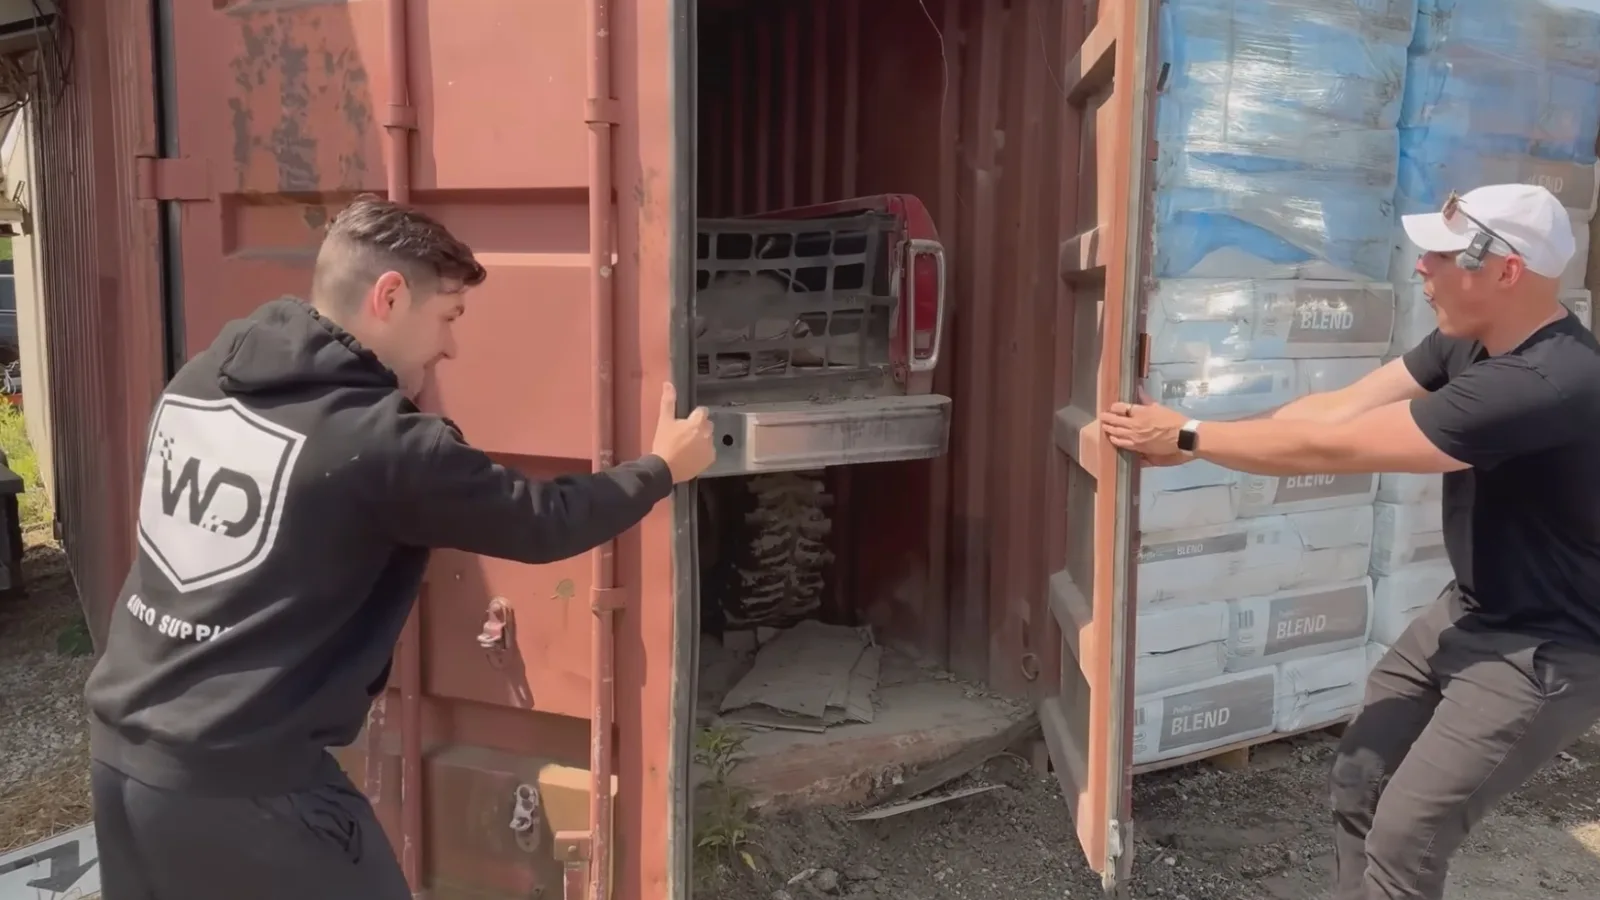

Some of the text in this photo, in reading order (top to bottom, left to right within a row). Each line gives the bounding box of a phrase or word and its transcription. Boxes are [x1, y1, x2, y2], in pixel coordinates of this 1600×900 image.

[1300, 311, 1354, 330] BLEND
[159, 431, 262, 538] WD
[1286, 474, 1336, 489] BLEND
[1177, 544, 1204, 556] BLEND
[127, 594, 233, 642] AUTO SUPPL
[1276, 614, 1327, 640] BLEND
[1171, 707, 1230, 736] BLEND
